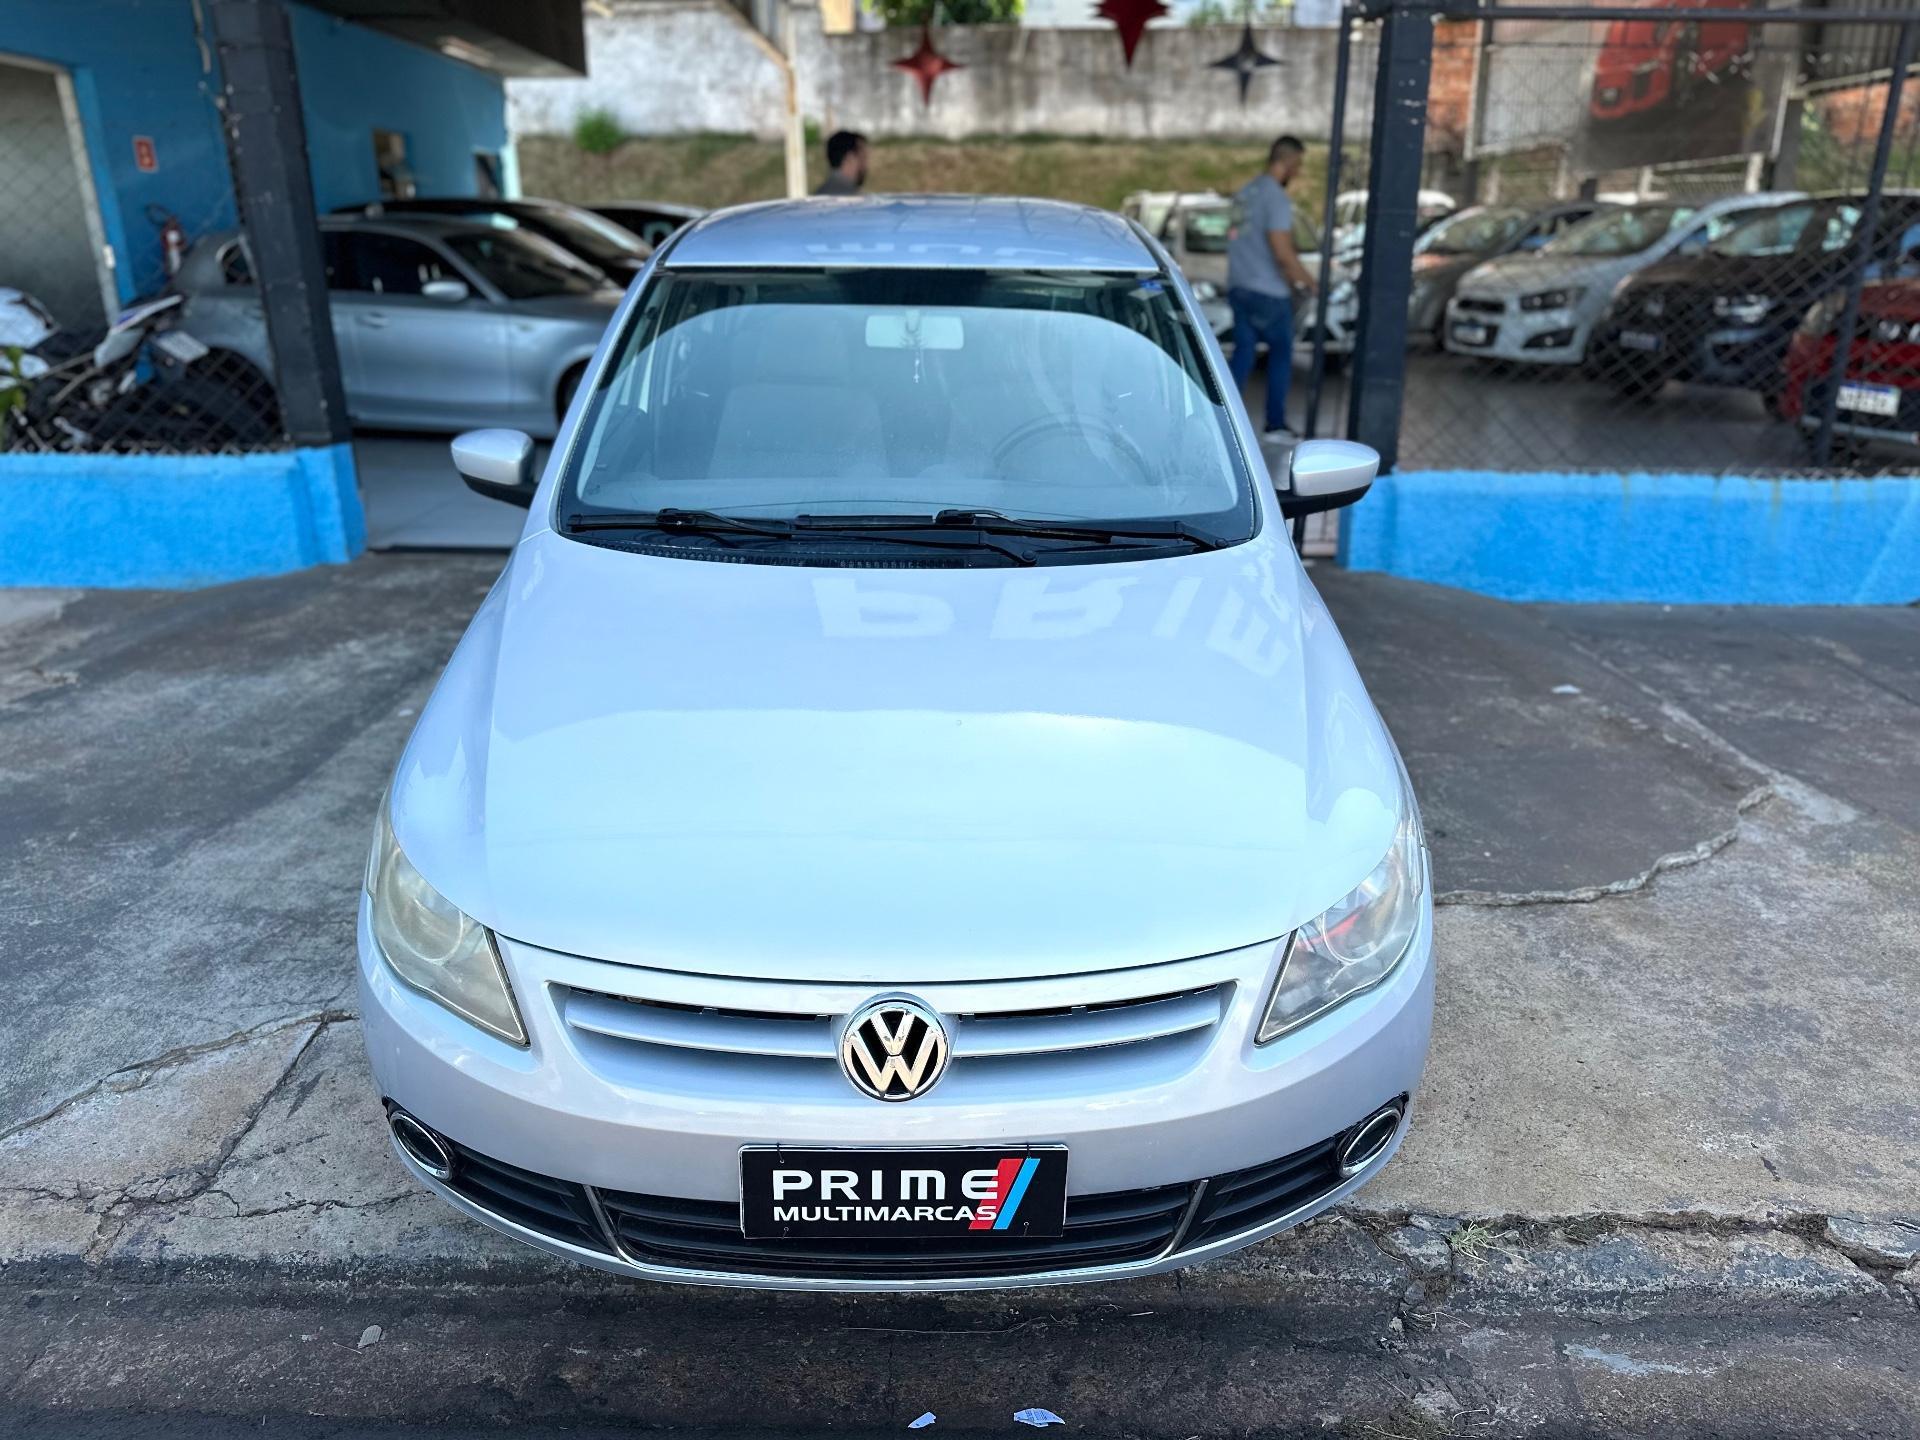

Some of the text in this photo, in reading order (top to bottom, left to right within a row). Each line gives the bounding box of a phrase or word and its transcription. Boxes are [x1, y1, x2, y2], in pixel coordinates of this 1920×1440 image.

[843, 1009, 949, 1097] VW
[772, 1169, 999, 1201] PRIME
[773, 1205, 998, 1222] MULTIMARCAS
